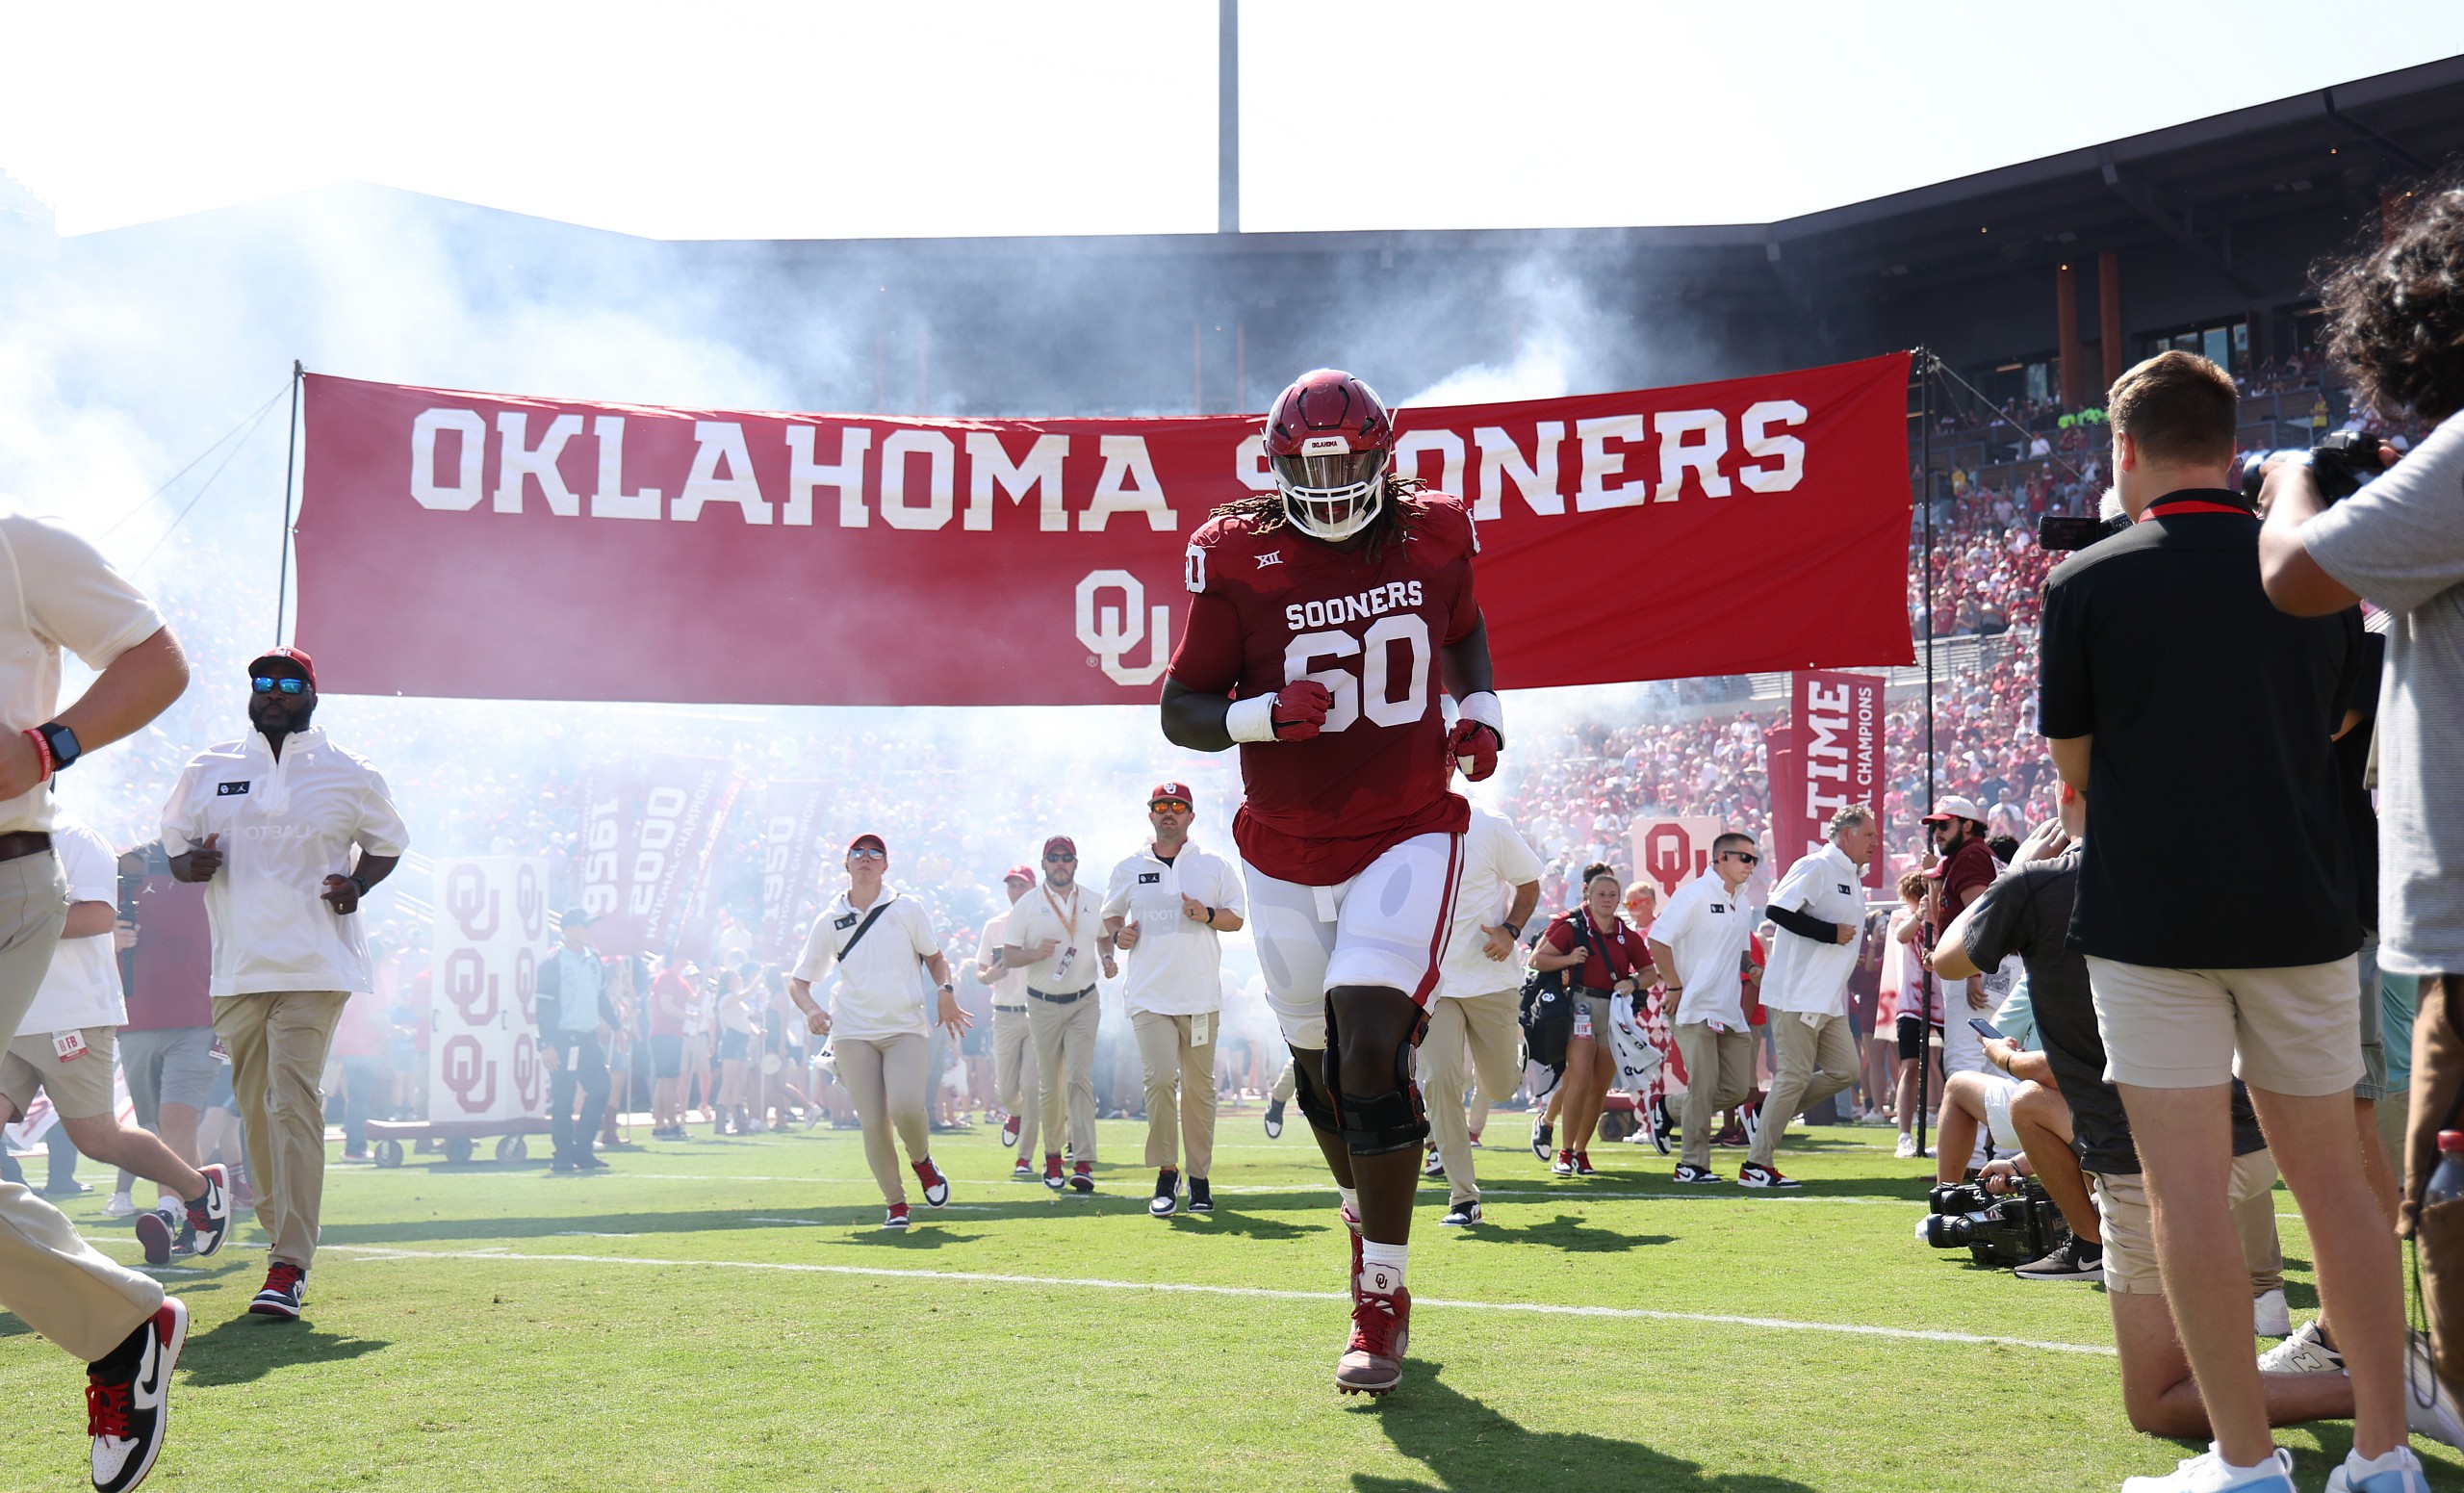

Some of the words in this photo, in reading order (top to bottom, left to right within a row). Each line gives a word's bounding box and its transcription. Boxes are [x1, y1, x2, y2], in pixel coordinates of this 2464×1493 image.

[411, 408, 1177, 532] OKLAHOMA
[1236, 399, 1808, 521] ONERS
[1311, 440, 1338, 449] OKLAHOMA
[1185, 544, 1206, 594] 0
[1254, 551, 1284, 569] XII
[1076, 570, 1169, 686] OU
[1286, 580, 1423, 630] SOONERS
[1284, 613, 1431, 733] 60
[1857, 686, 1872, 785] CHAMPIONS
[1163, 781, 1177, 794] OU
[583, 798, 619, 914] 1956
[631, 786, 687, 914] 2000
[646, 860, 680, 939] NATIONAL
[675, 770, 717, 858] CHAMPIONS
[762, 816, 796, 921] 1950
[775, 875, 797, 946] NATIONAL
[792, 790, 822, 871] CHAMPIONS
[446, 863, 500, 940] OU
[517, 863, 543, 941] OU
[445, 948, 499, 1026] OU
[65, 1035, 78, 1049] FB
[443, 1035, 496, 1113] OU
[514, 1034, 540, 1111] OU
[1375, 1273, 1388, 1289] OU
